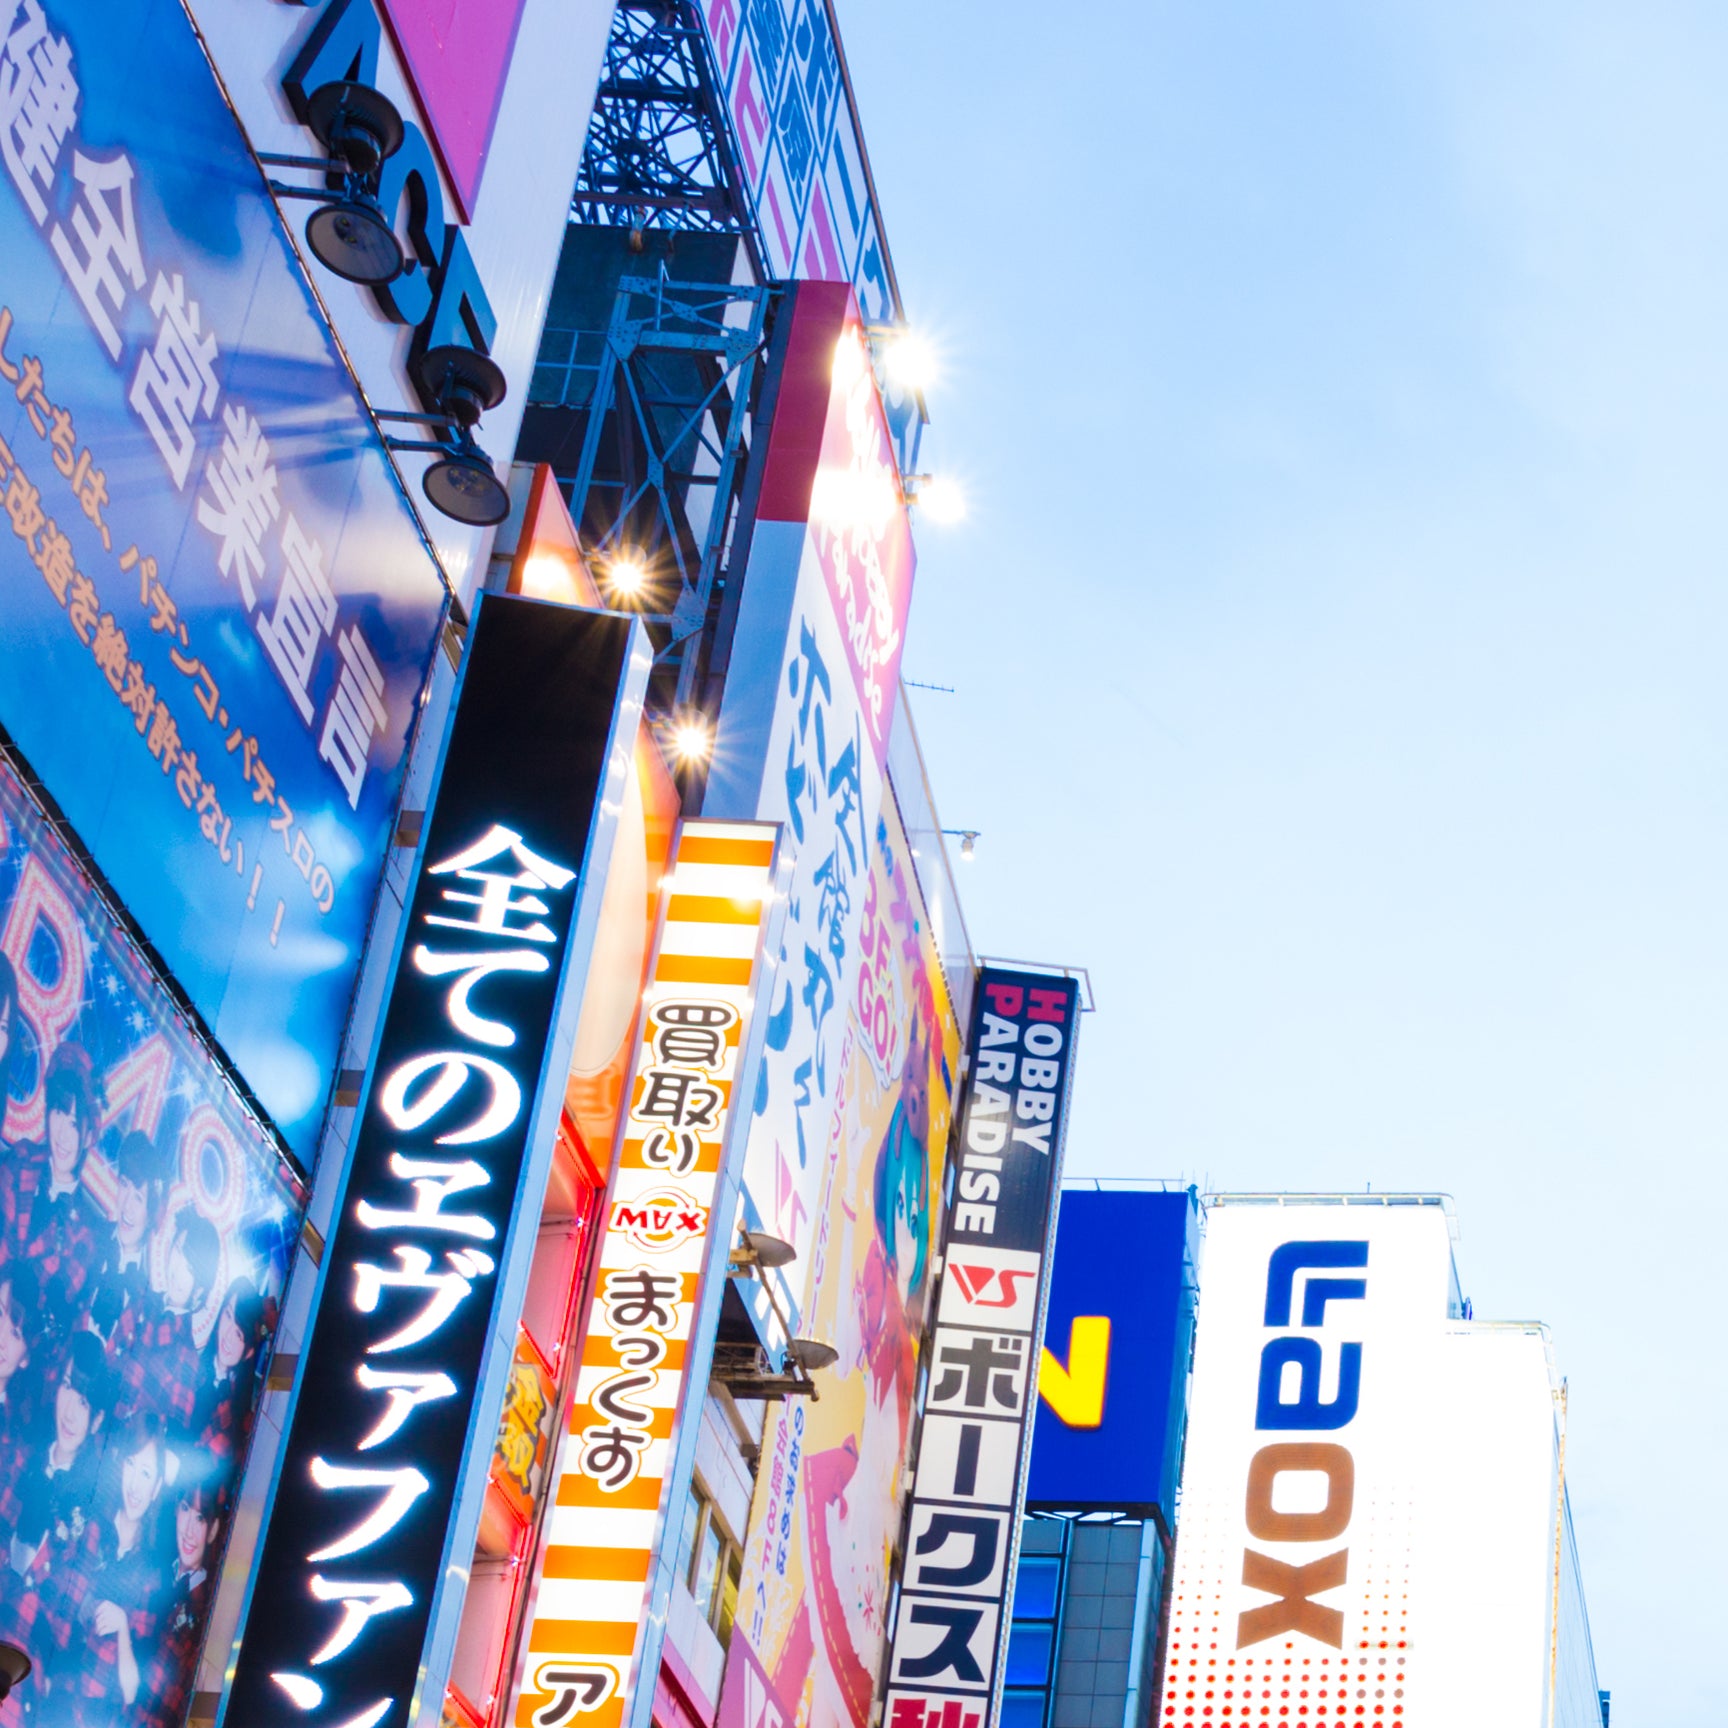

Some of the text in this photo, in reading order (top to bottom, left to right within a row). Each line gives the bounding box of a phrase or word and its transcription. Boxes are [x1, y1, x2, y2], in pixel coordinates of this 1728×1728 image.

[640, 1003, 733, 1172] 買取り
[952, 982, 1028, 1236] PARADISE
[1012, 988, 1070, 1157] HOBBY
[585, 1268, 686, 1490] まっくす
